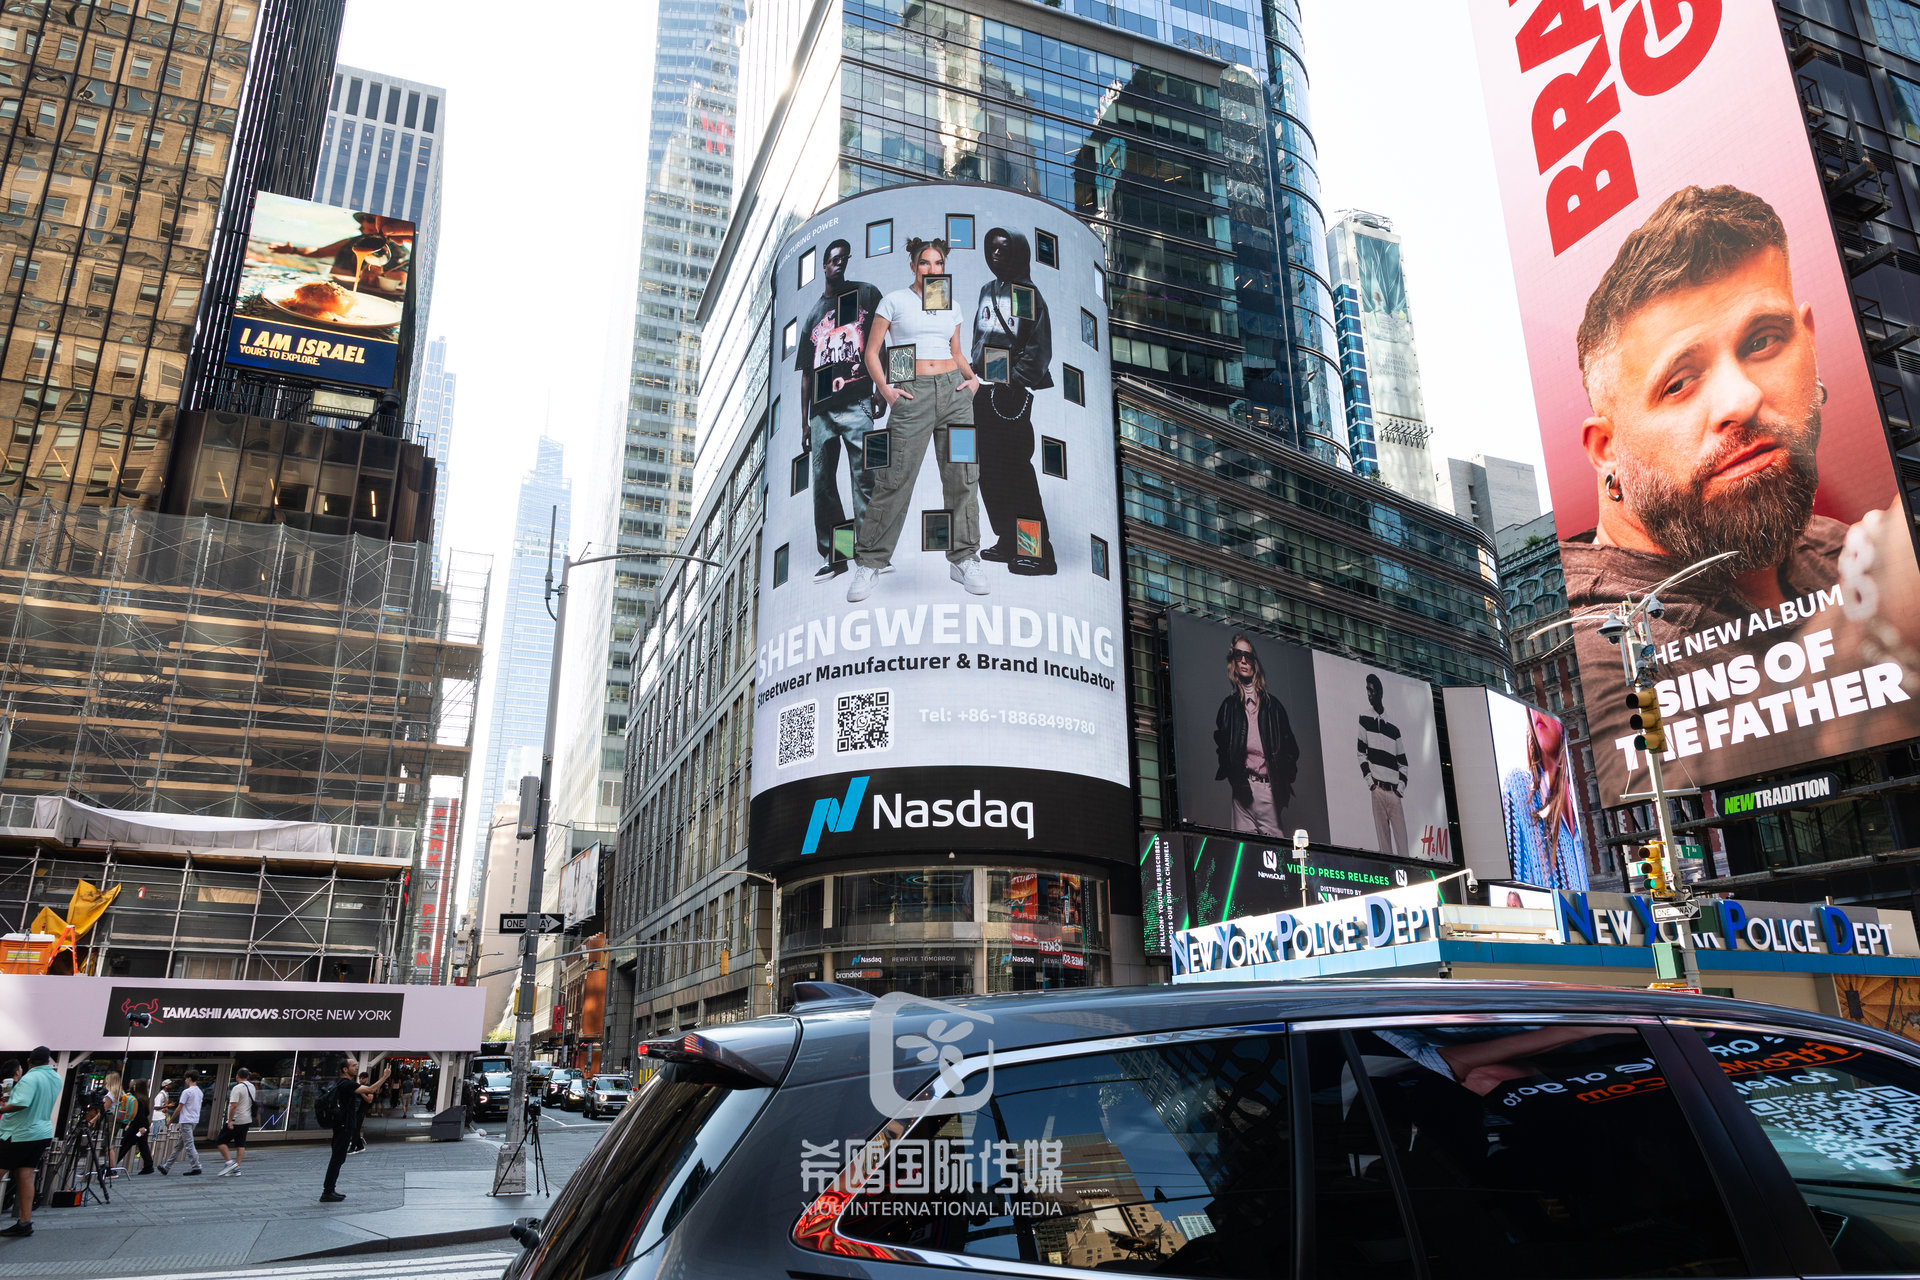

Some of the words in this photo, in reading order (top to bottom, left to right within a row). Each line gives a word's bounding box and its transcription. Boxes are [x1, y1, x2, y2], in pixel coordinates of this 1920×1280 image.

[1508, 0, 1639, 257] BRA
[812, 217, 840, 238] POWER
[240, 328, 252, 345] I
[252, 331, 293, 352] AM
[296, 337, 366, 364] ISRAEL
[240, 345, 268, 357] YOURS
[268, 350, 280, 359] TO
[281, 351, 321, 366] EXPLORE.
[1654, 639, 1682, 665] HE
[1685, 619, 1742, 657] NEW
[1747, 584, 1844, 637] ALBUM
[757, 604, 1115, 687] SHENGWENDING
[757, 672, 812, 709] Streetwear
[815, 653, 951, 682] Manufacturer
[956, 653, 971, 669] &
[977, 653, 1038, 675] Brand
[1043, 660, 1115, 692] Incubator
[1654, 655, 1761, 718] SINS
[1764, 628, 1835, 683] OF
[919, 708, 952, 723] Tel:
[958, 709, 1096, 735] +86-18868498780
[1703, 662, 1912, 750] FATHER
[873, 789, 1034, 840] Nasdaq
[427, 807, 447, 867] PARK
[1421, 824, 1449, 860] H&M
[1154, 836, 1162, 881] SUBSCRIBERS
[1287, 863, 1316, 876] VIDEO
[1318, 867, 1345, 880] PRESS
[1348, 872, 1390, 886] RELEASES
[1156, 882, 1164, 914] YOUTUBE
[1320, 885, 1354, 895] DISTRIBUTED
[506, 919, 525, 928] ONE
[540, 919, 552, 928] AY
[1552, 889, 1633, 945] NEW
[1716, 900, 1821, 953] POLICE
[1818, 905, 1893, 956] DEPT
[1678, 905, 1694, 914] WAY
[416, 903, 435, 966] PARK
[1170, 932, 1215, 975] NEW
[1214, 924, 1275, 968] YORK
[1276, 912, 1359, 961] POLICE
[1365, 896, 1440, 948] DEPT
[835, 969, 881, 980] brandedcities
[861, 956, 882, 964] Nasdaq
[1012, 955, 1035, 964] Nasdaq
[162, 1007, 222, 1019] TAMASHII
[282, 1009, 323, 1022] STORE
[326, 1010, 356, 1021] NEW
[357, 1010, 392, 1022] YORK
